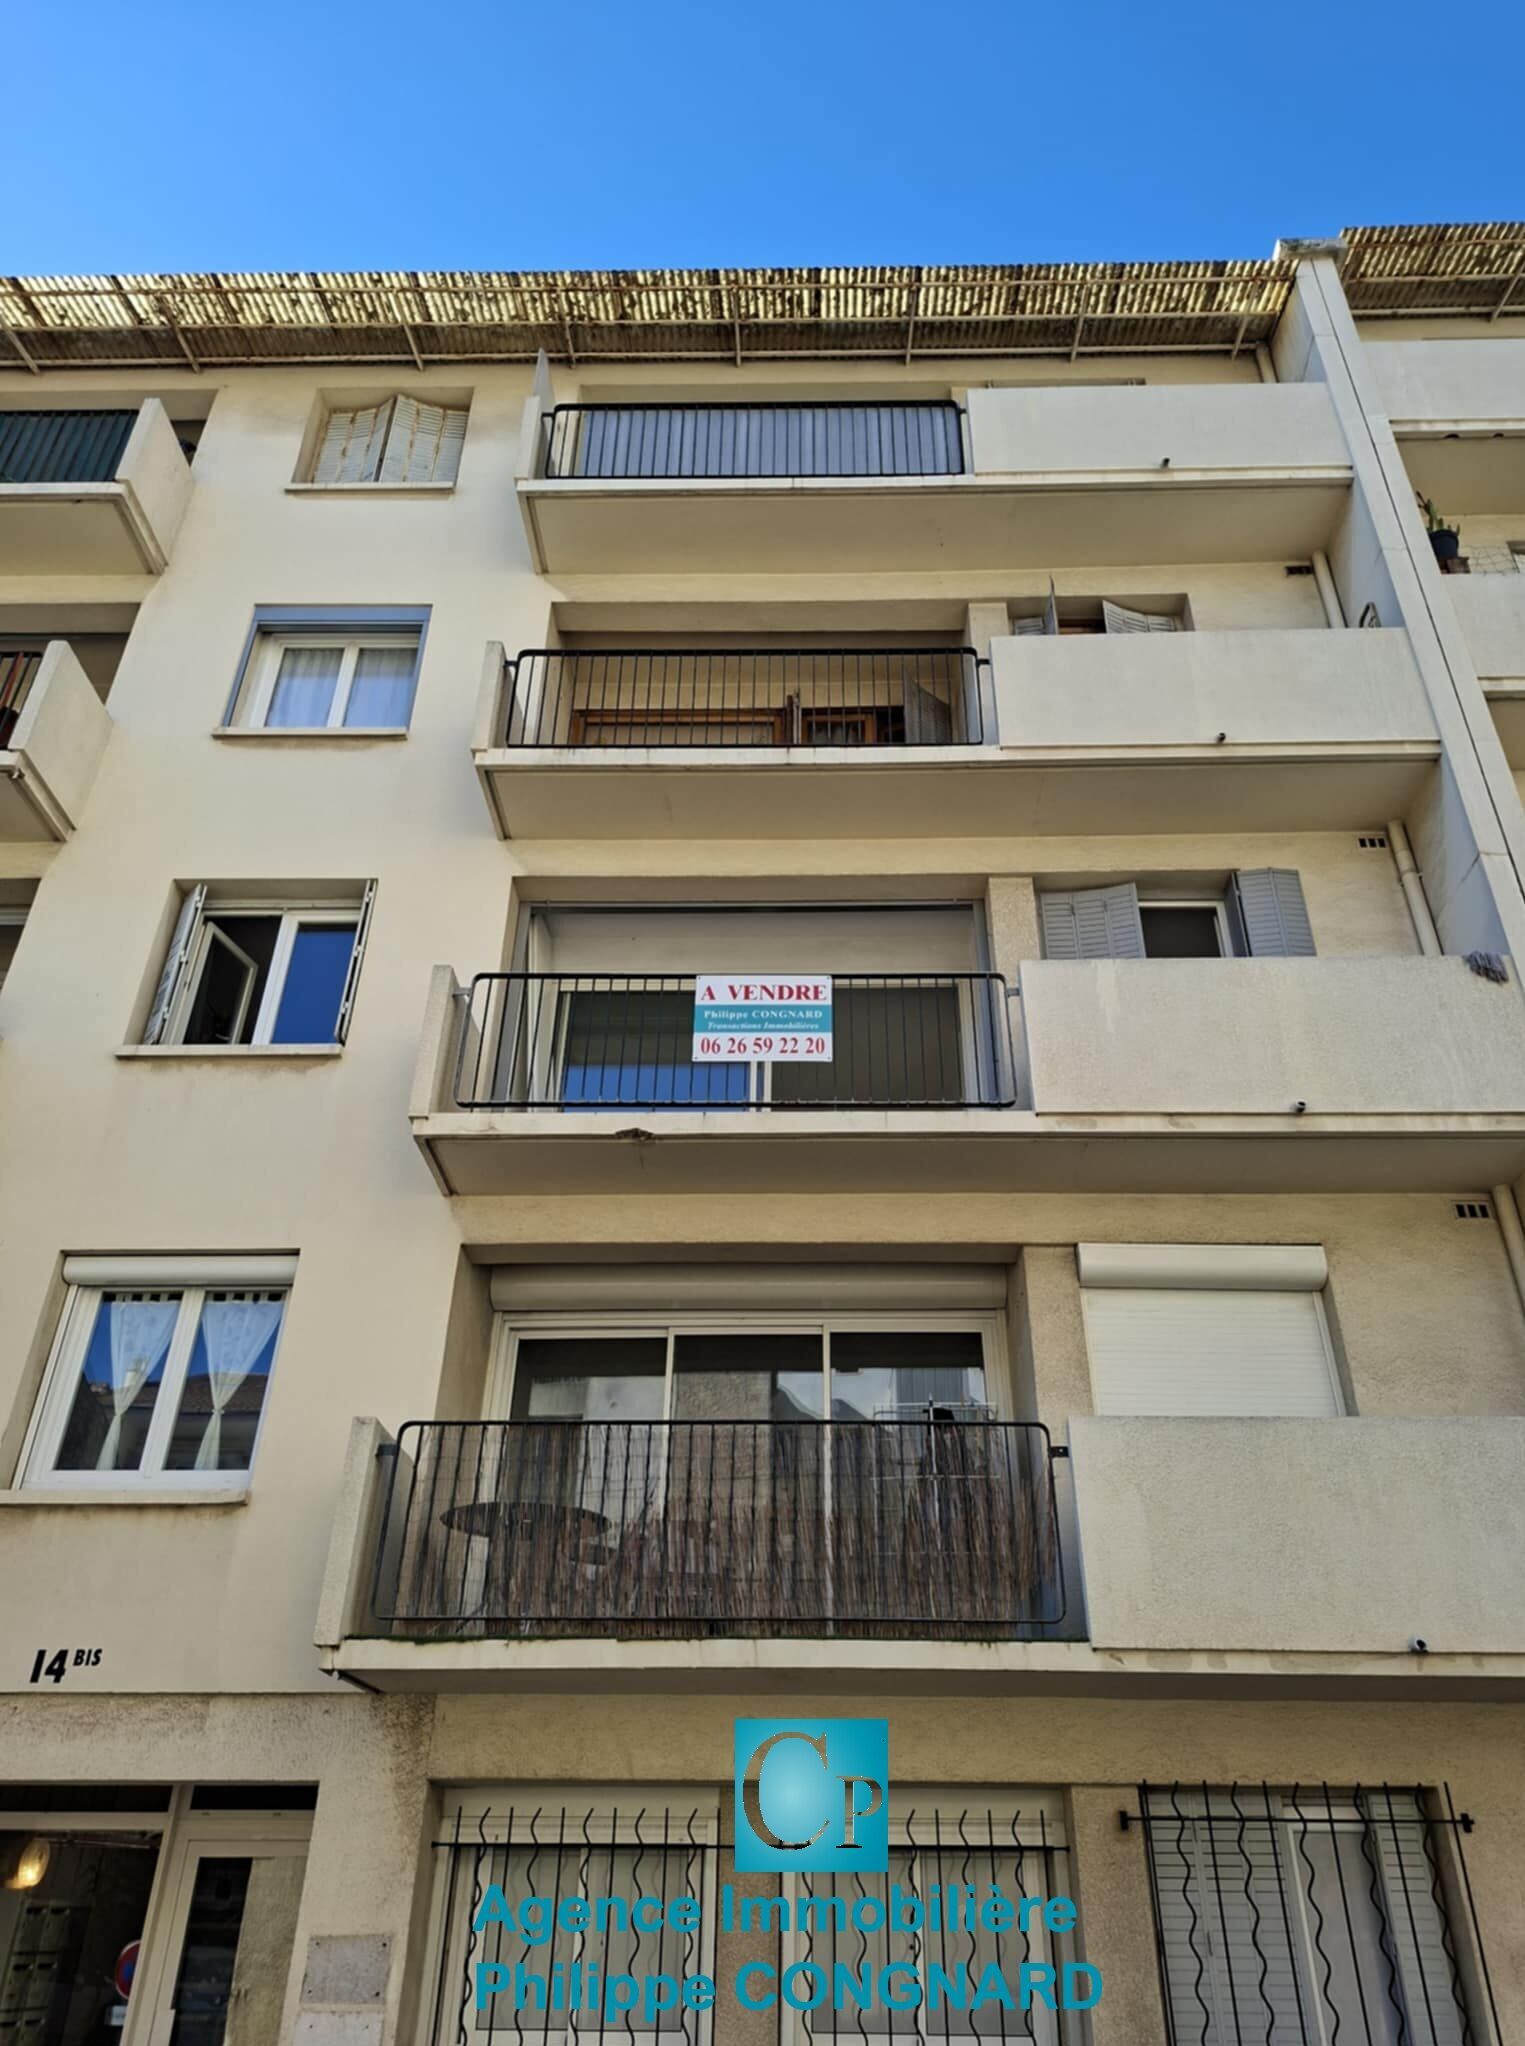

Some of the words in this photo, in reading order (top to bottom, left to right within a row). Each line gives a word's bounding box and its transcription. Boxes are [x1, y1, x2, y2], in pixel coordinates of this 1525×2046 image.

[701, 985, 716, 1000] A
[728, 984, 827, 1000] VENDRE
[704, 1010, 748, 1020] Philippe
[751, 1010, 823, 1019] CONGNARD
[707, 1022, 762, 1030] Transactions
[701, 1037, 721, 1054] 06
[727, 1037, 747, 1054] 26
[752, 1037, 773, 1054] 59
[779, 1037, 799, 1054] 22
[805, 1037, 825, 1054] 20
[29, 1649, 69, 1683] 14
[73, 1648, 102, 1666] BIS
